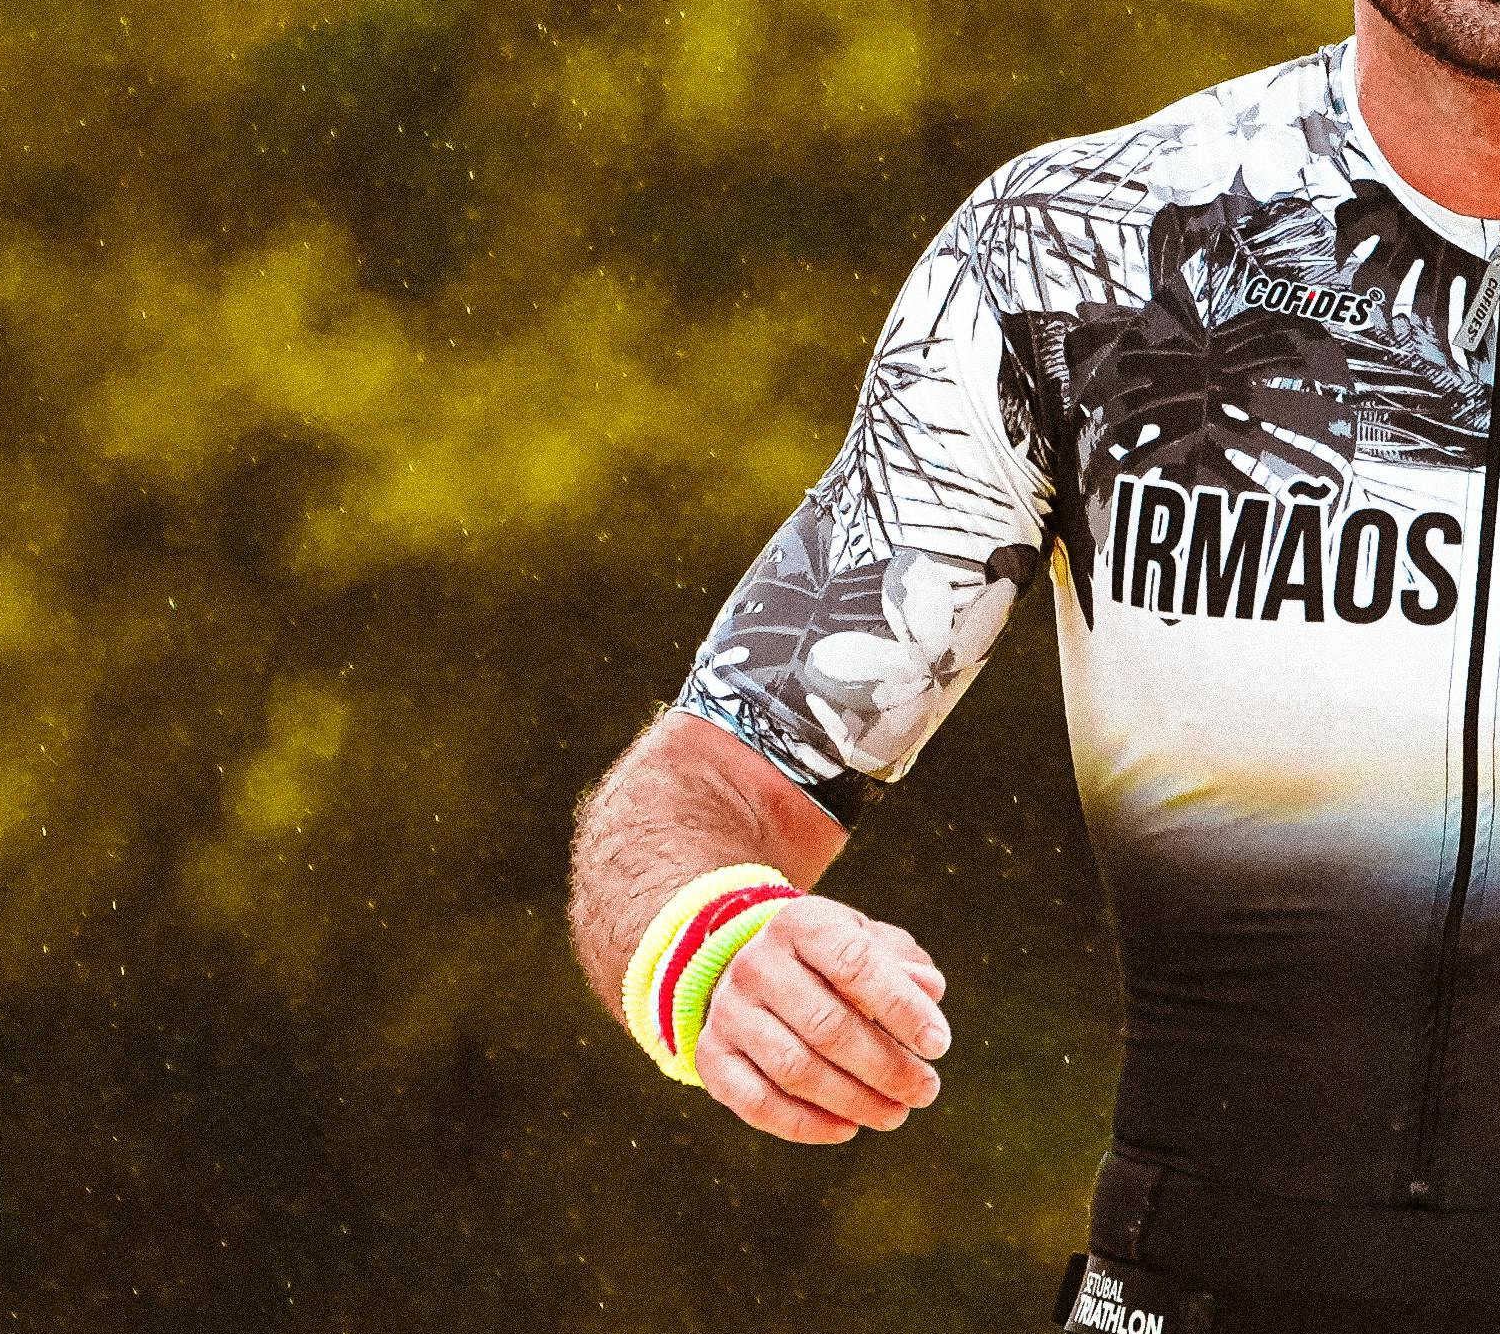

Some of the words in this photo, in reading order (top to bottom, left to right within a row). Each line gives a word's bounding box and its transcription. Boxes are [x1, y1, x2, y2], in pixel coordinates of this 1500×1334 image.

[1244, 277, 1373, 326] COFIDES
[1467, 277, 1499, 336] COFIDES
[1111, 477, 1463, 626] IRMÃOS
